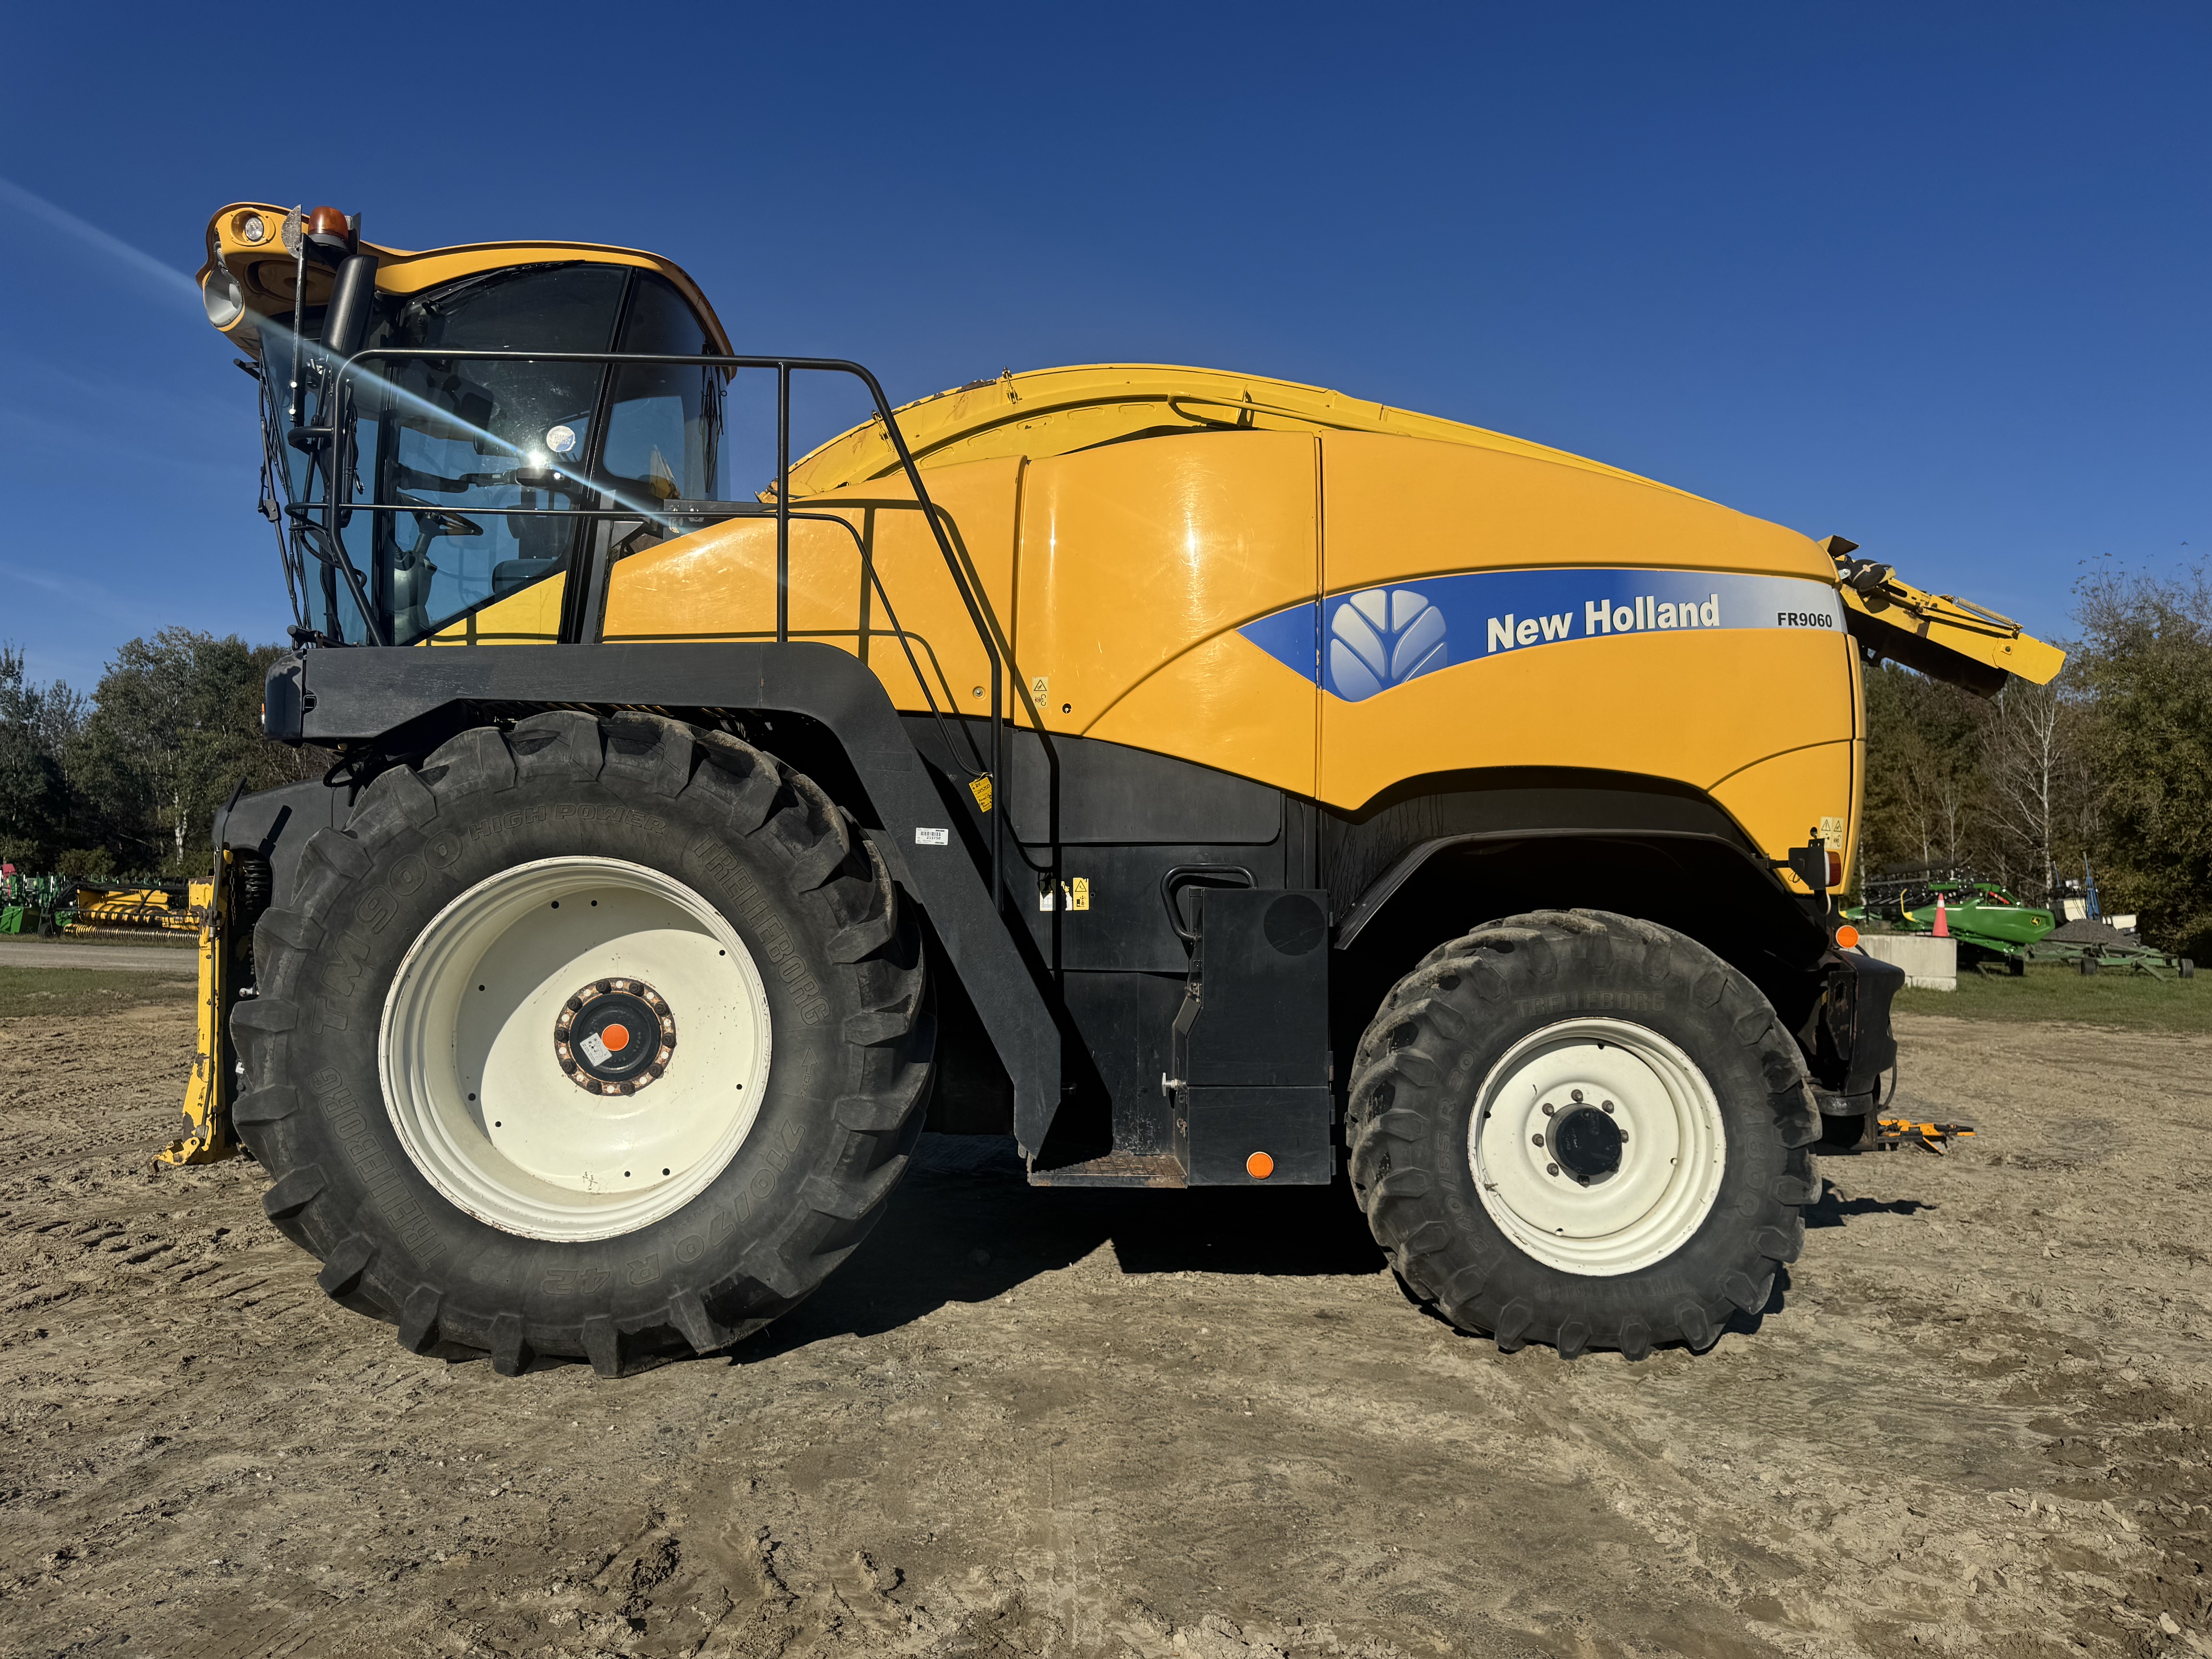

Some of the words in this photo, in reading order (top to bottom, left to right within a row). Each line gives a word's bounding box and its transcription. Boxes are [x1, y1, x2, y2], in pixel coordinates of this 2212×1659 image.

[1488, 612, 1573, 652] New
[1585, 594, 1719, 634] Holland
[1778, 612, 1832, 627] FR9060
[468, 805, 546, 841] HIGH
[555, 804, 668, 834] POWER
[311, 930, 370, 1035] TM
[355, 829, 463, 934] 900
[693, 828, 831, 1026] TRELLEBORG
[1513, 990, 1665, 1019] TRELLEBORG
[1448, 1051, 1475, 1093] 30
[1724, 1058, 1766, 1127] TM
[1437, 1097, 1456, 1123] R
[309, 1067, 447, 1274] TRELLEBORG
[675, 1118, 806, 1264] 710/70
[1436, 1130, 1490, 1255] 540/65
[1736, 1132, 1769, 1218] 800
[541, 1268, 611, 1295] 42
[627, 1253, 661, 1286] R
